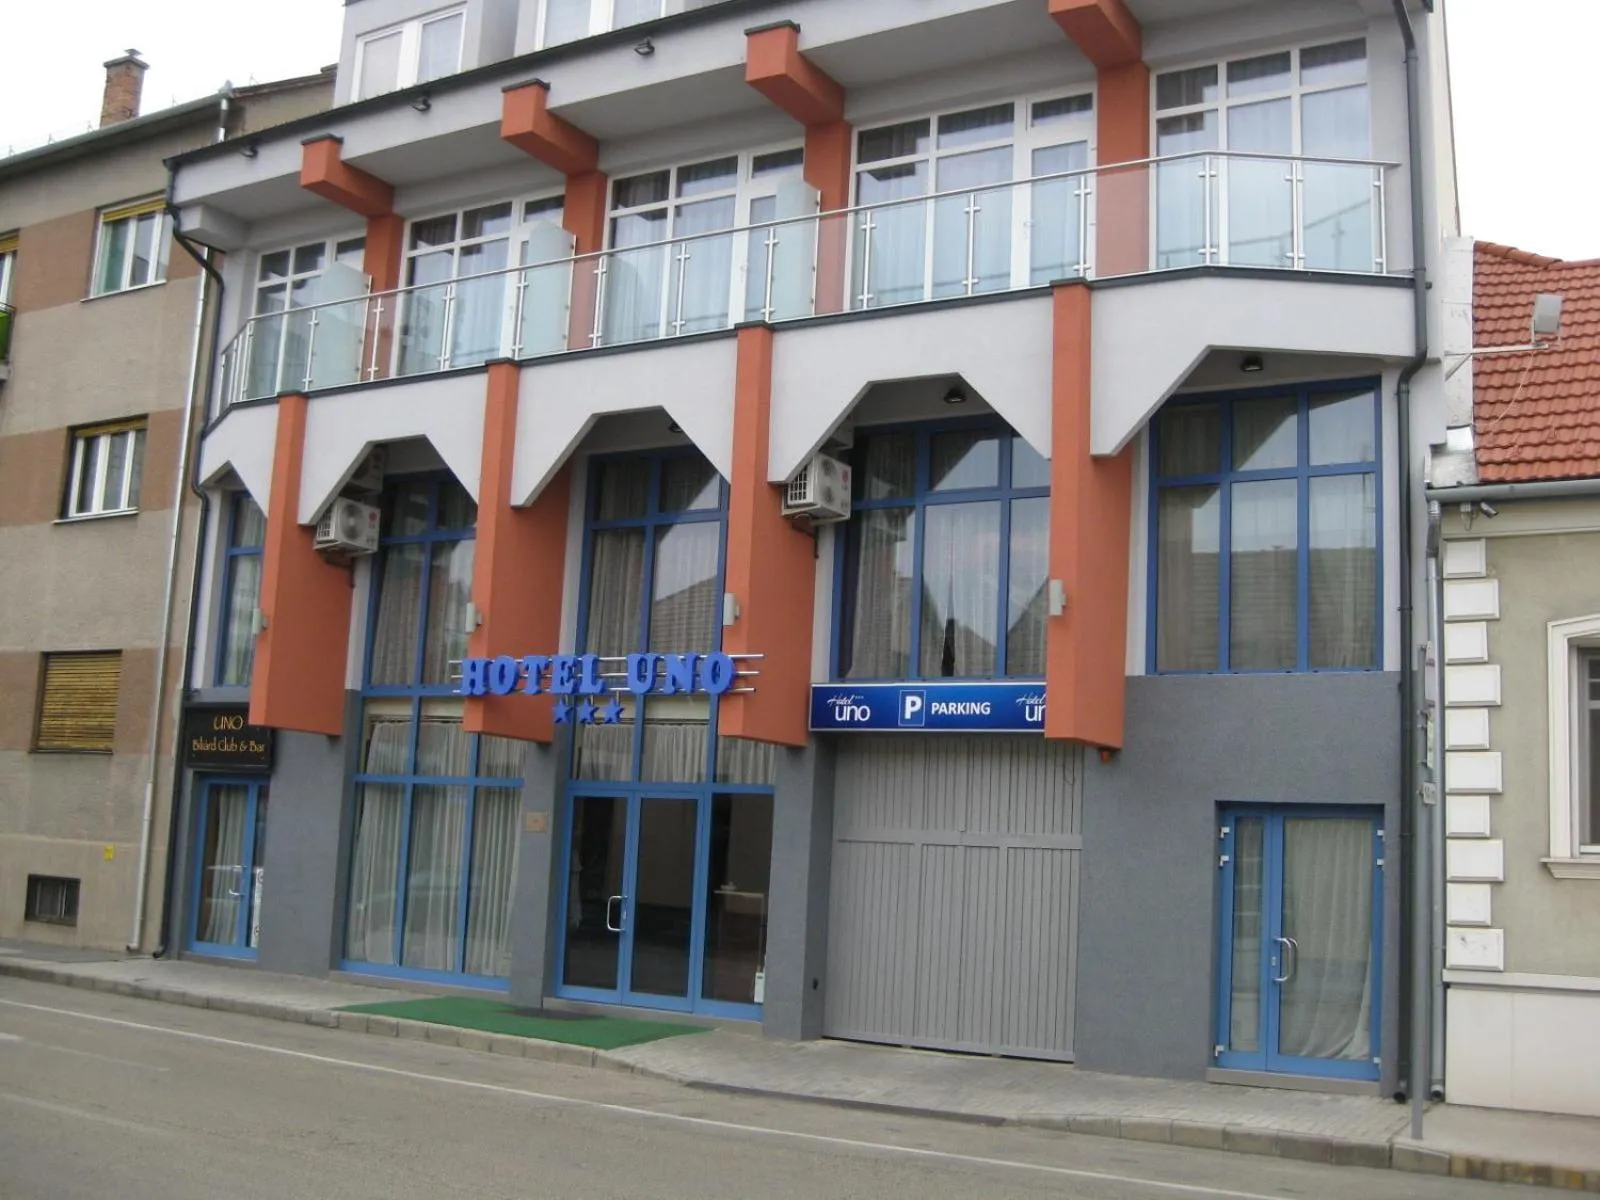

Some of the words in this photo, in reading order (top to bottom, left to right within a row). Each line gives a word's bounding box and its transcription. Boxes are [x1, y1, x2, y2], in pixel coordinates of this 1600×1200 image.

[461, 655, 604, 696] HOTEL
[626, 652, 736, 695] UNO
[827, 694, 854, 707] Hotel
[904, 695, 922, 720] P
[931, 702, 991, 715] PARKING
[835, 705, 871, 721] uno
[213, 714, 243, 731] UNO
[218, 736, 237, 752] Club
[239, 741, 248, 752] &
[249, 740, 265, 752] Bar
